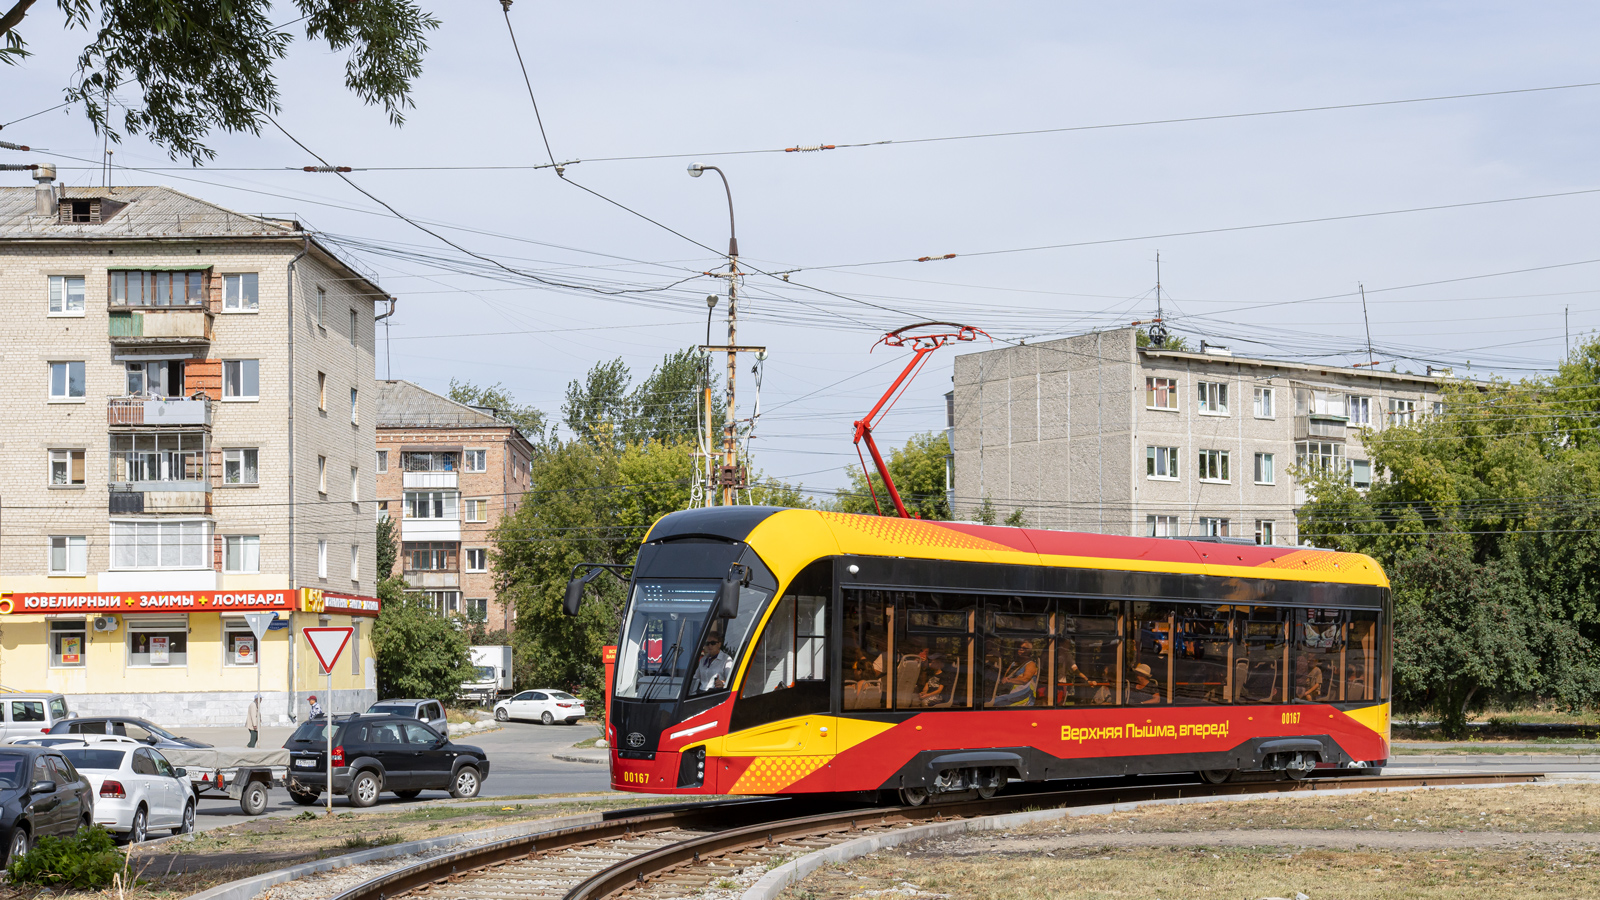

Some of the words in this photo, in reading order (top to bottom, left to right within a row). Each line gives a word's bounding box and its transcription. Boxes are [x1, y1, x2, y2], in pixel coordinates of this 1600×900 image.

[24, 596, 121, 608] ЮВЕЛИРНЫЙ
[139, 595, 194, 607] ЗАЙМЫ
[212, 593, 285, 606] ЛОМБАРД
[1281, 712, 1300, 724] 00167
[1061, 725, 1123, 744] Верхняя
[1125, 723, 1177, 740] Пышма,
[1179, 720, 1229, 739] вперед!
[624, 771, 650, 784] 00167
